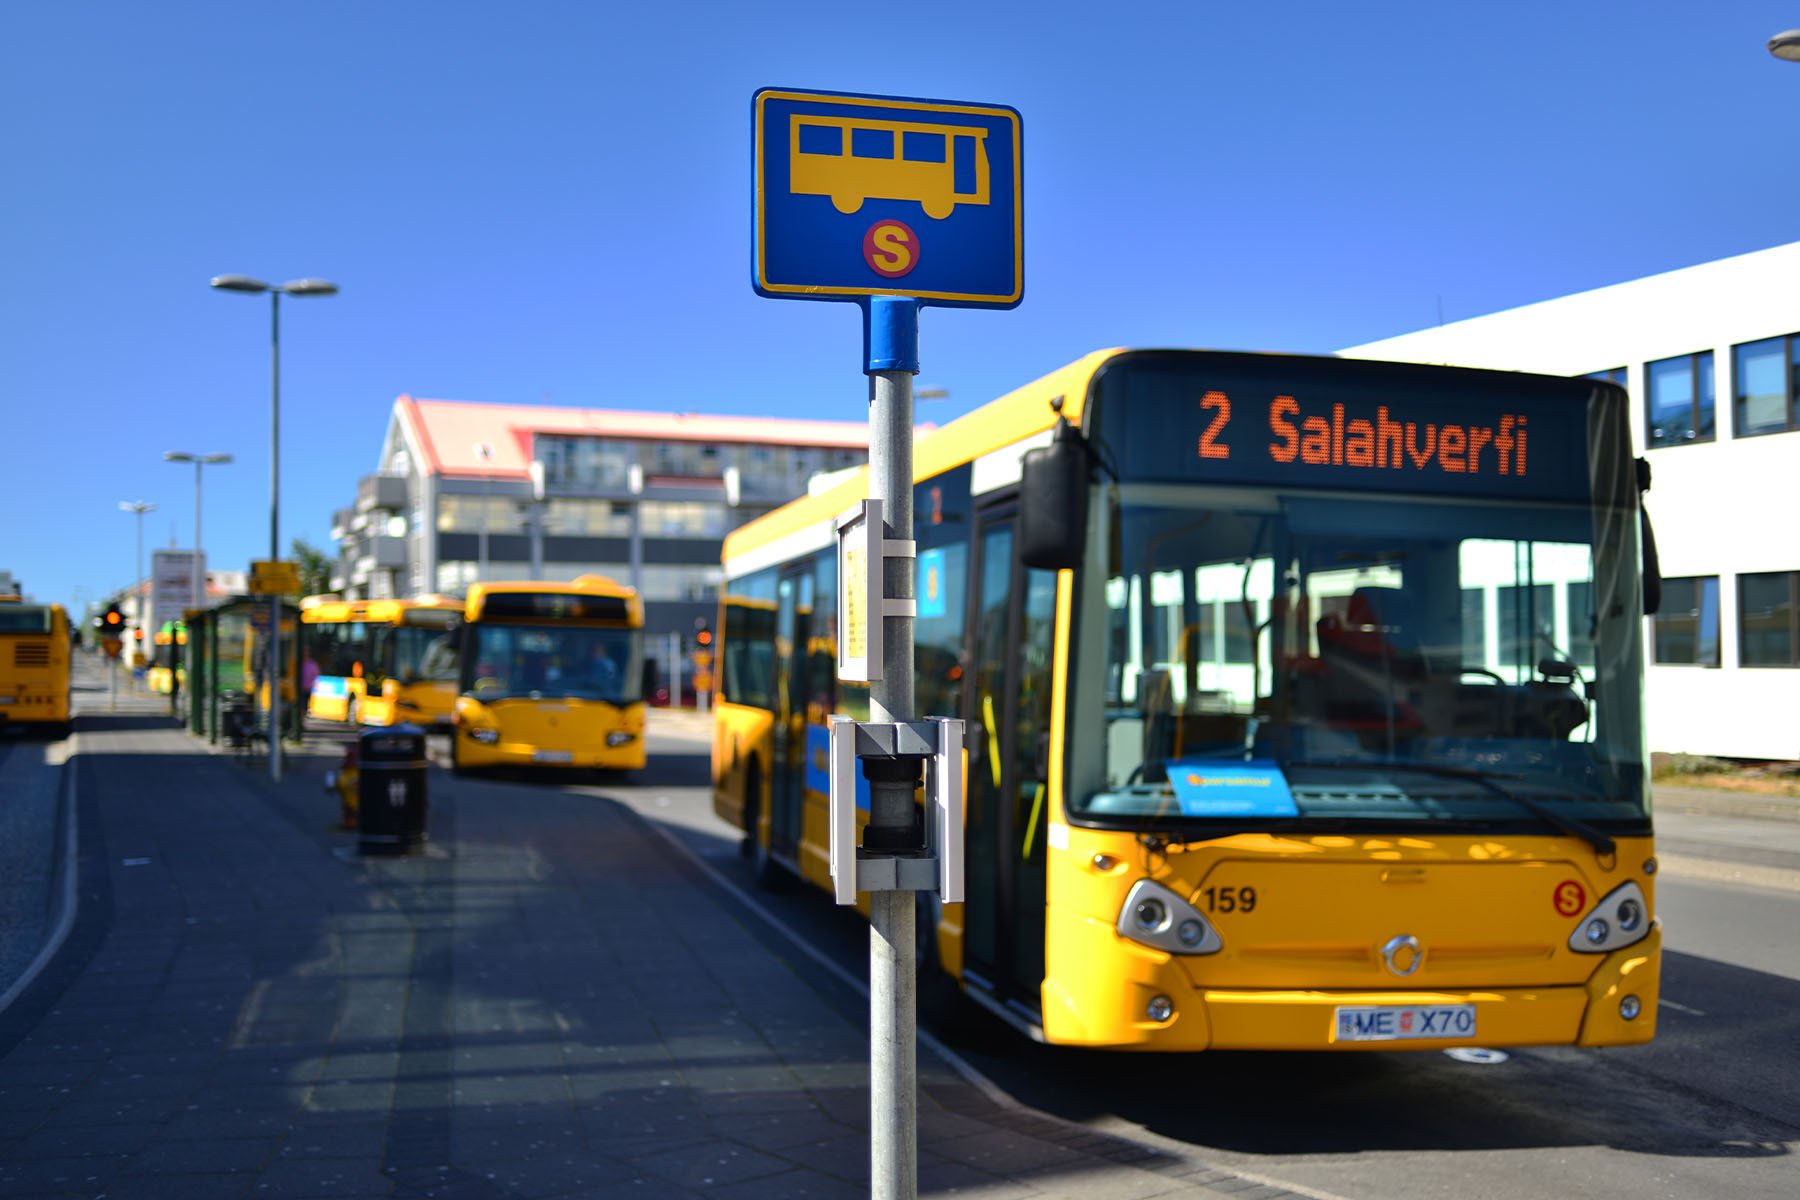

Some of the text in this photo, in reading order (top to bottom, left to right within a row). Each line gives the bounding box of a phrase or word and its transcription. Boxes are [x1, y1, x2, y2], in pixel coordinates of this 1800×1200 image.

[872, 225, 911, 272] S
[1198, 391, 1528, 477] 2 Salahverfi
[1203, 886, 1256, 914] 159
[1559, 885, 1580, 912] S
[1355, 1010, 1472, 1034] ME X70
